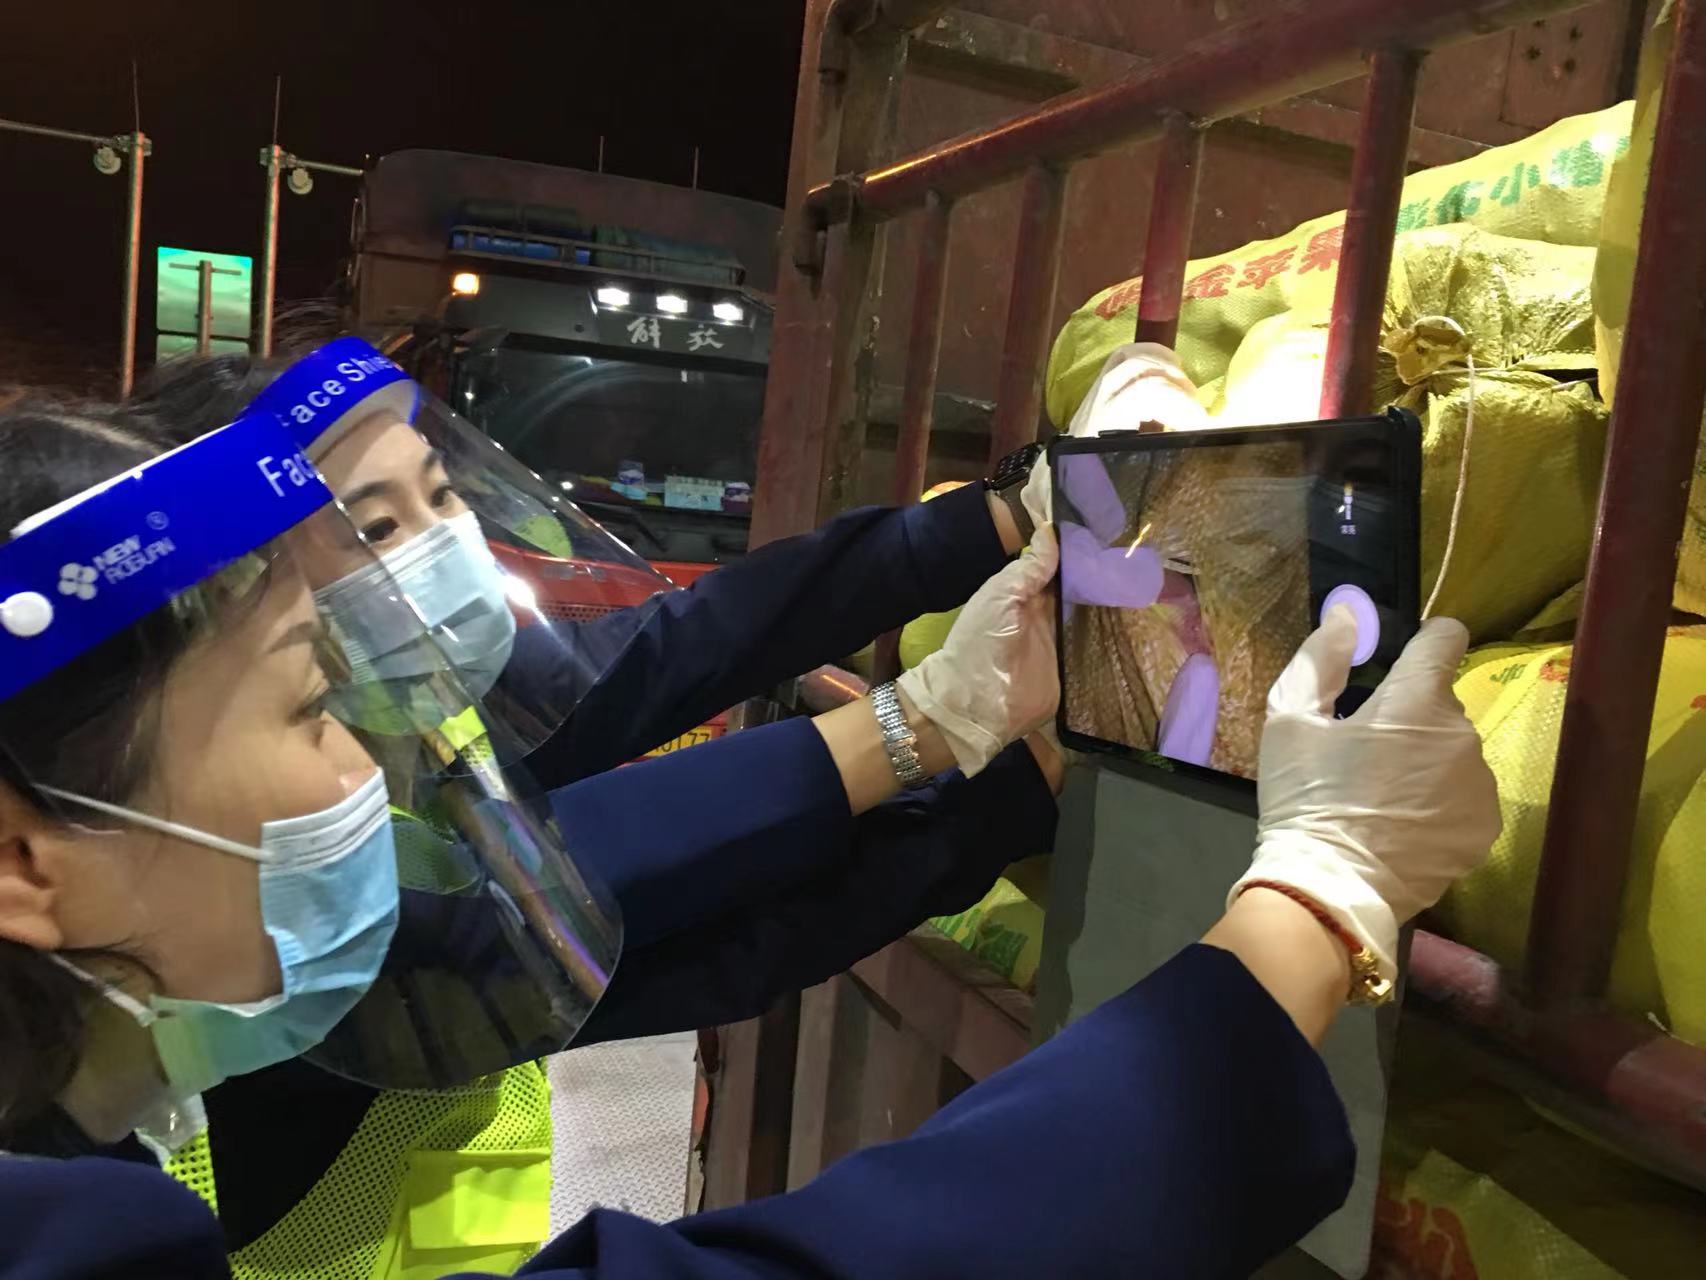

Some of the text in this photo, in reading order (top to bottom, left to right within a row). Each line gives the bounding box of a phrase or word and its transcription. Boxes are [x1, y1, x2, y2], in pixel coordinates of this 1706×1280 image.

[626, 316, 724, 351] 解放
[274, 379, 347, 427] ace
[256, 449, 317, 497] Fac
[93, 534, 141, 571] NEW
